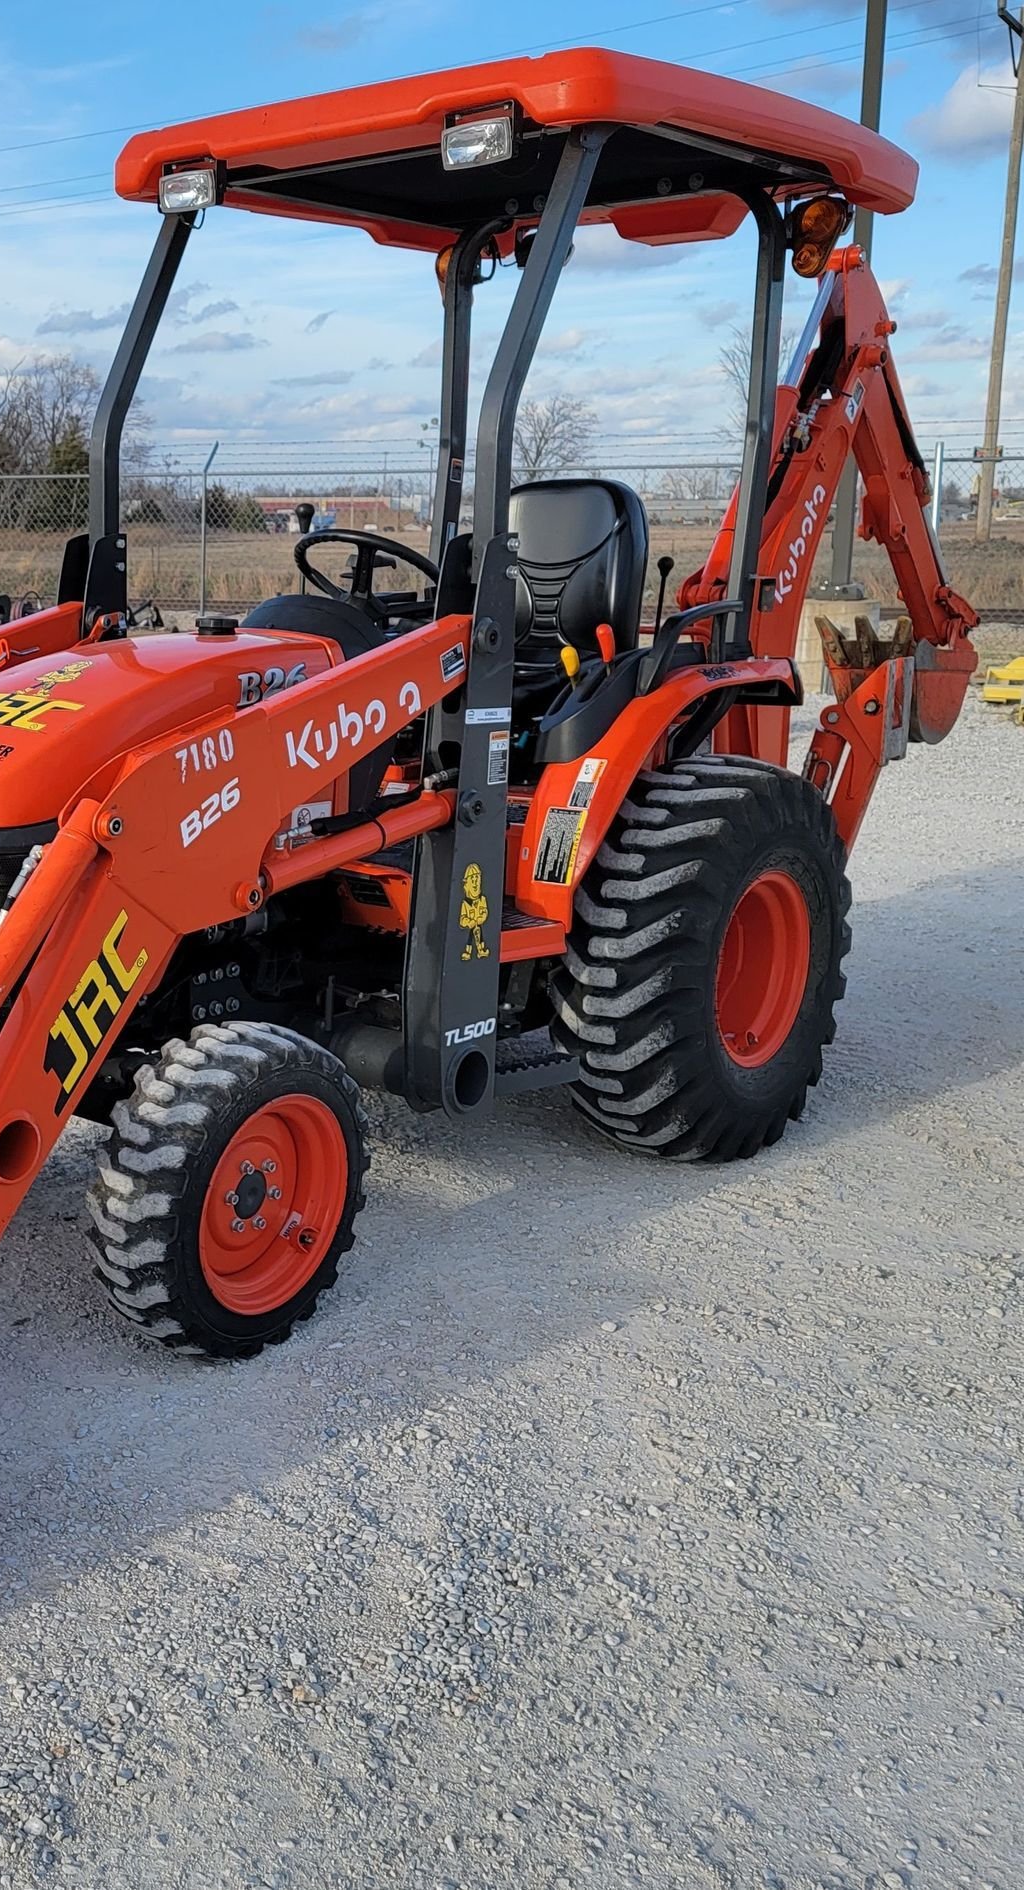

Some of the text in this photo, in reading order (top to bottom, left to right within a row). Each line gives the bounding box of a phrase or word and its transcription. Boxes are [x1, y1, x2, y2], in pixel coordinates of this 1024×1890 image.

[774, 484, 826, 604] Kubota
[237, 663, 308, 708] B26
[175, 728, 235, 784] 7180
[179, 776, 241, 849] B26
[48, 908, 149, 1095] JRC
[445, 1017, 497, 1047] TL500
